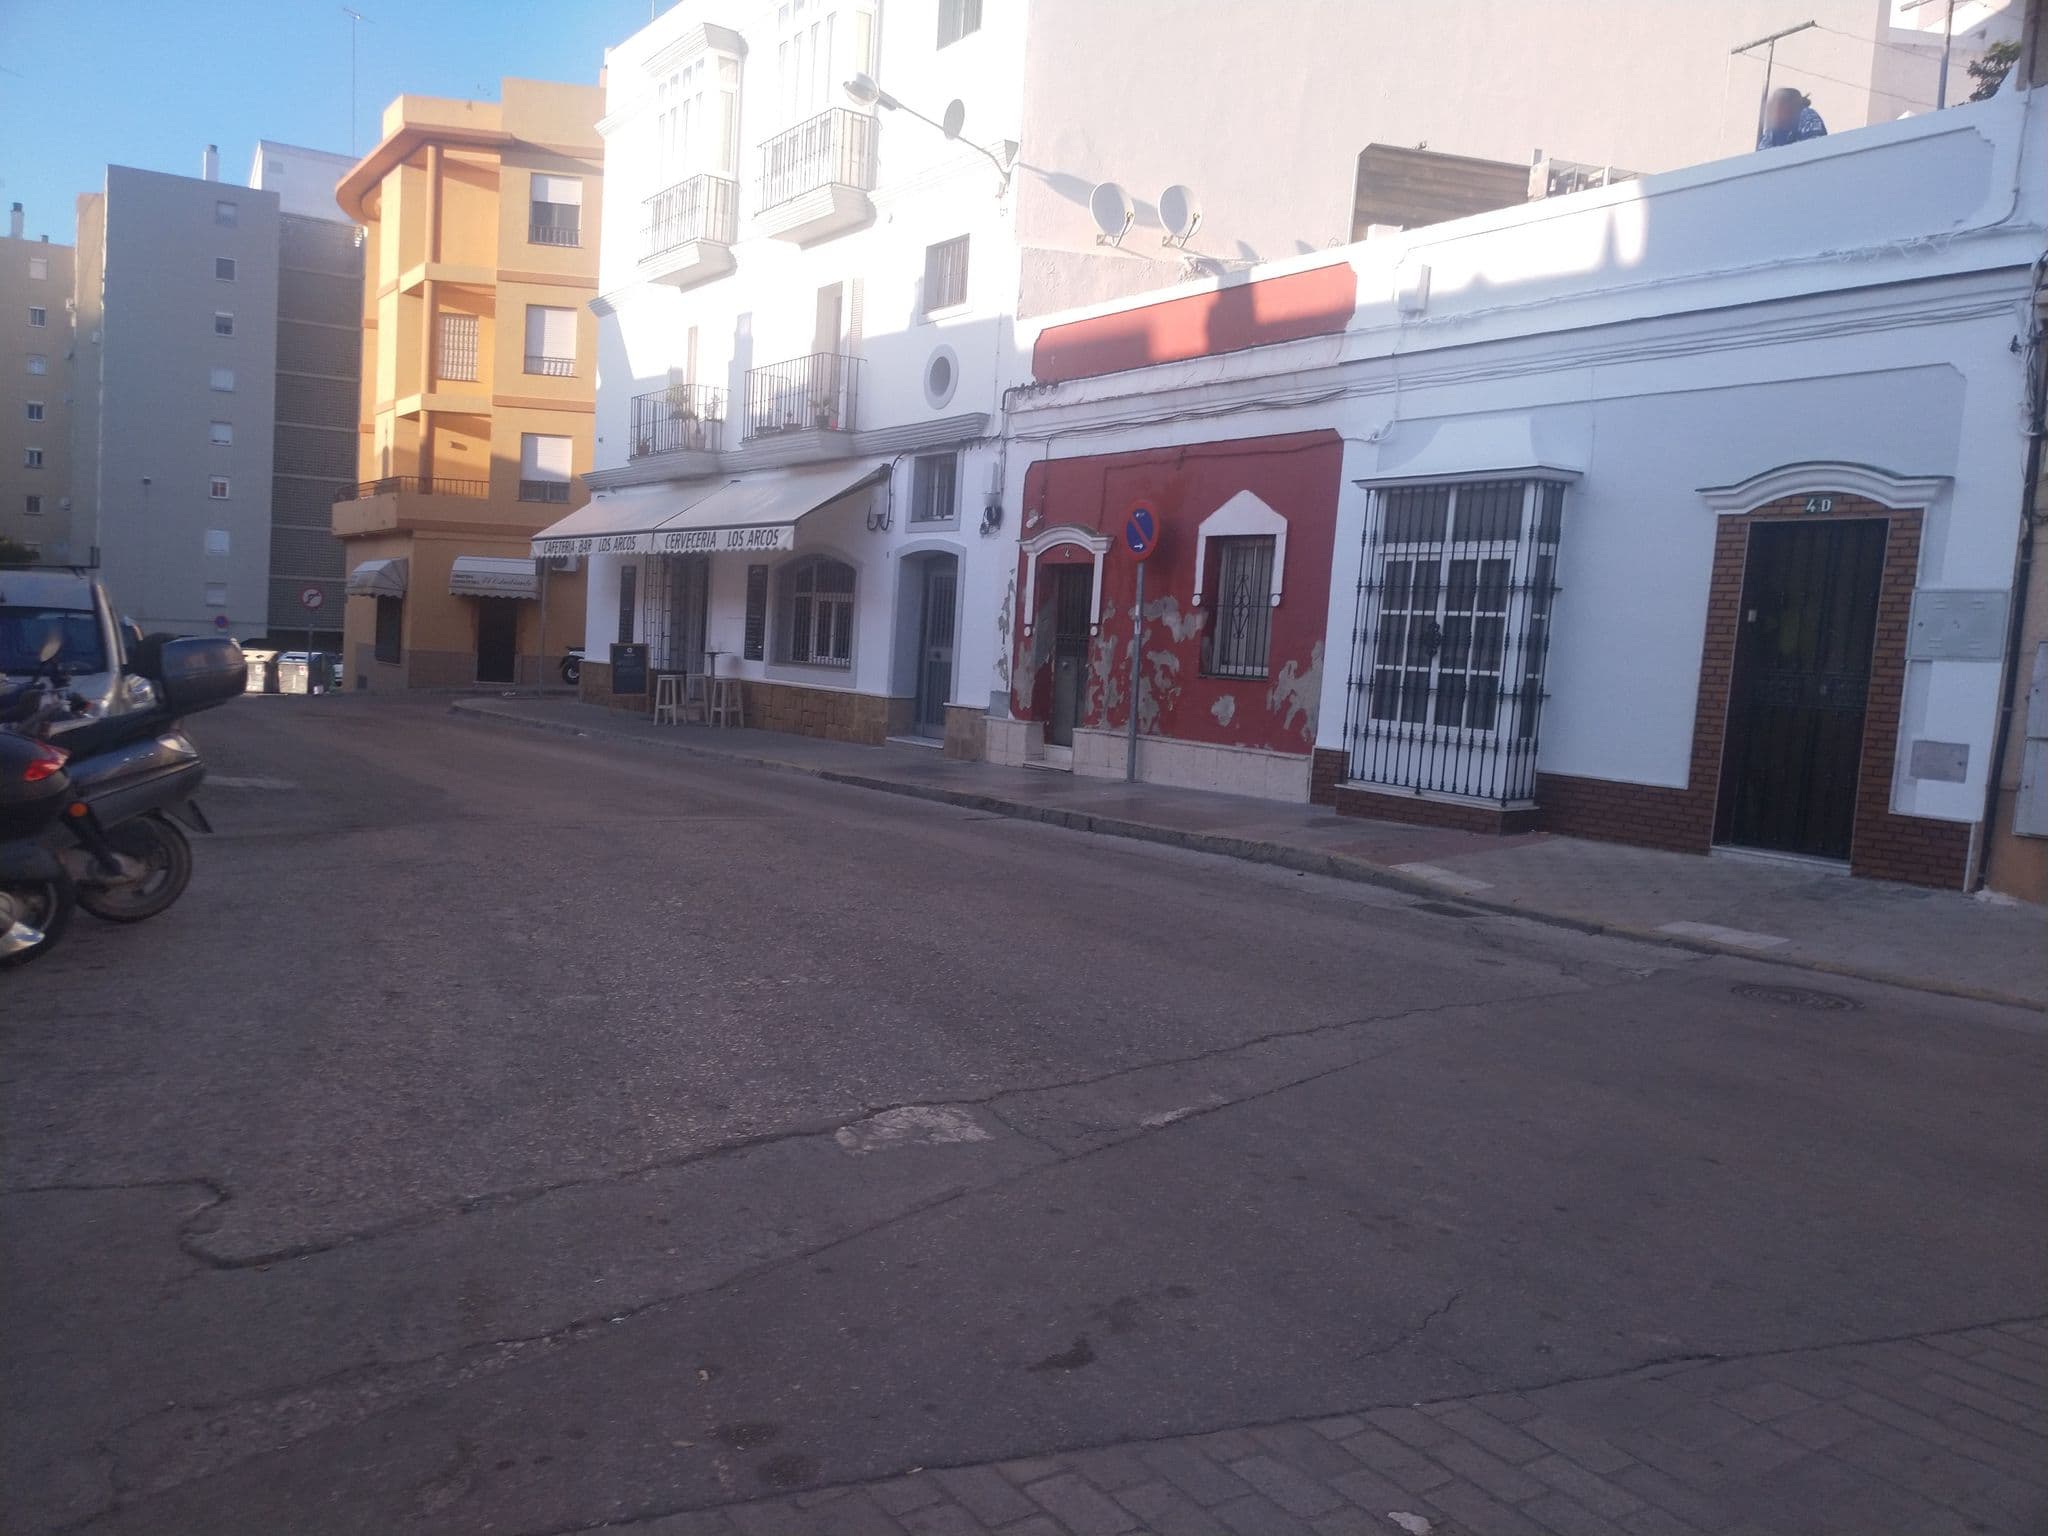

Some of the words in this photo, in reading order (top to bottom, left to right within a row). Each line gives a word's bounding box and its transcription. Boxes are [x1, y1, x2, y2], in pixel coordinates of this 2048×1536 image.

[543, 540, 576, 555] CAFETERIA
[578, 539, 593, 553] BAR
[598, 537, 612, 552] LOS
[613, 535, 637, 552] ARCOS
[664, 531, 717, 549] CERVECERIA
[727, 530, 744, 547] LOS
[746, 528, 779, 546] ARCOS
